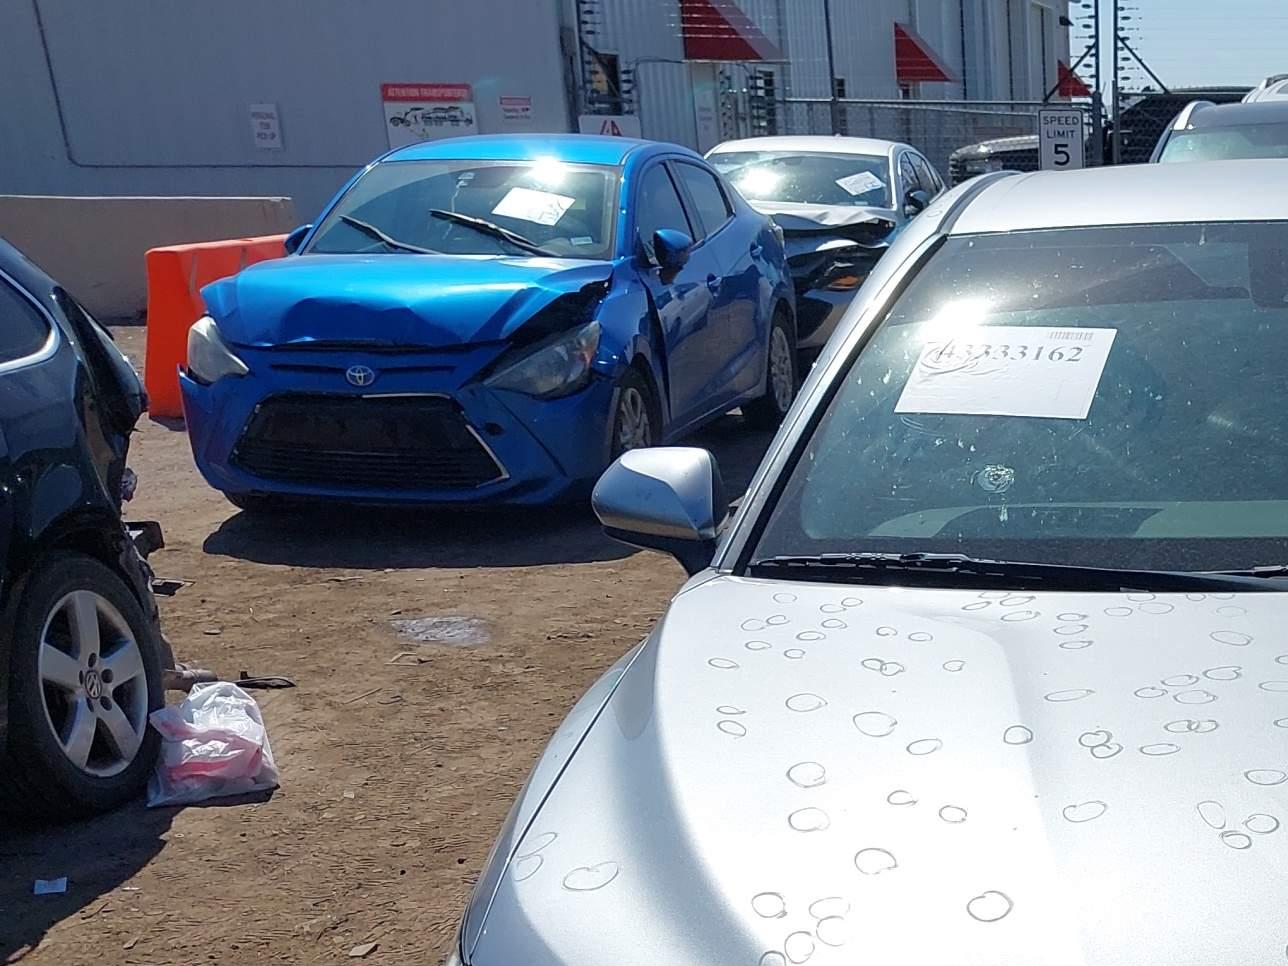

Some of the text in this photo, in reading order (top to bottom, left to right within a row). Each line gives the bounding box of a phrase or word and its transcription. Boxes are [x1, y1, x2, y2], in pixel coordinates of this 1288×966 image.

[1042, 115, 1080, 126] SPEED
[1046, 129, 1075, 139] LIMIT
[1053, 143, 1070, 166] 5
